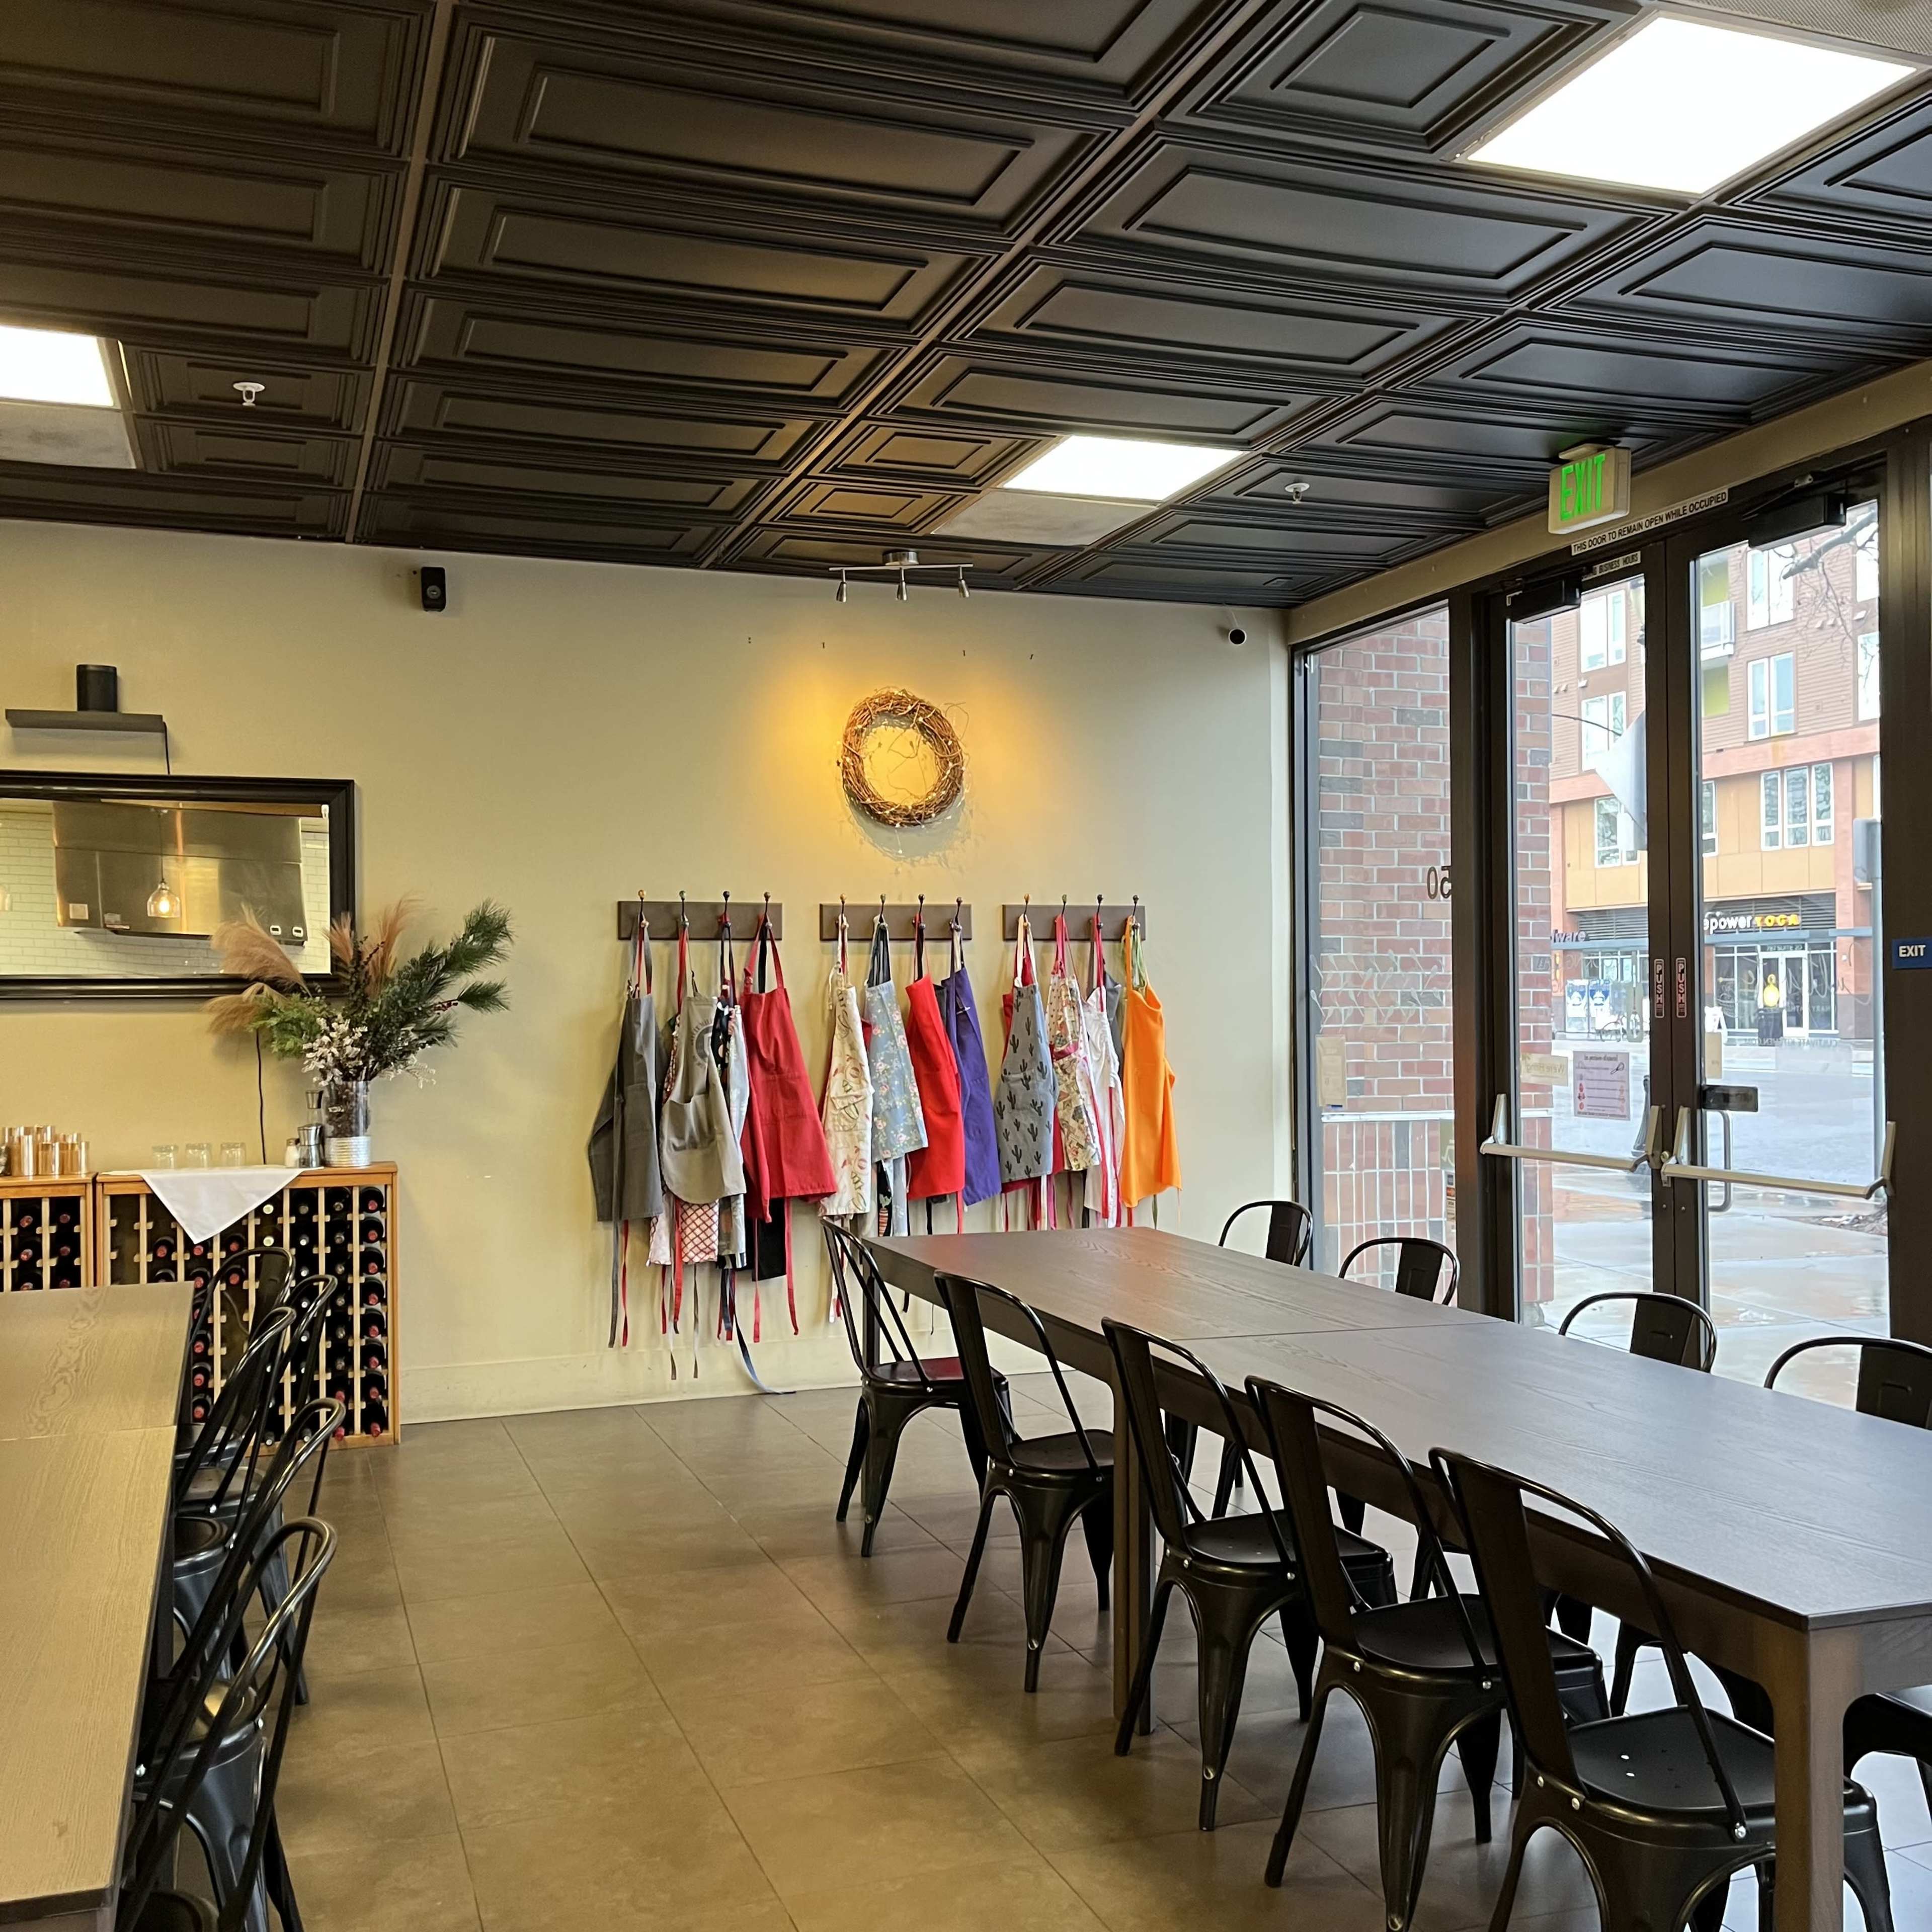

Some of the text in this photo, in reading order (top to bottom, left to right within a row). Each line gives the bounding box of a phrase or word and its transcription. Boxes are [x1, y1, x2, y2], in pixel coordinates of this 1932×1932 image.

[1561, 453, 1606, 521] EXIT
[1573, 492, 1726, 553] THIS DOOR TO REMAIN OPEN WHILE OCCUPIED
[1599, 559, 1620, 574] BUSINESS
[1623, 553, 1638, 566] HOURS
[1754, 914, 1800, 927] YOGA
[1899, 944, 1926, 957] EXIT
